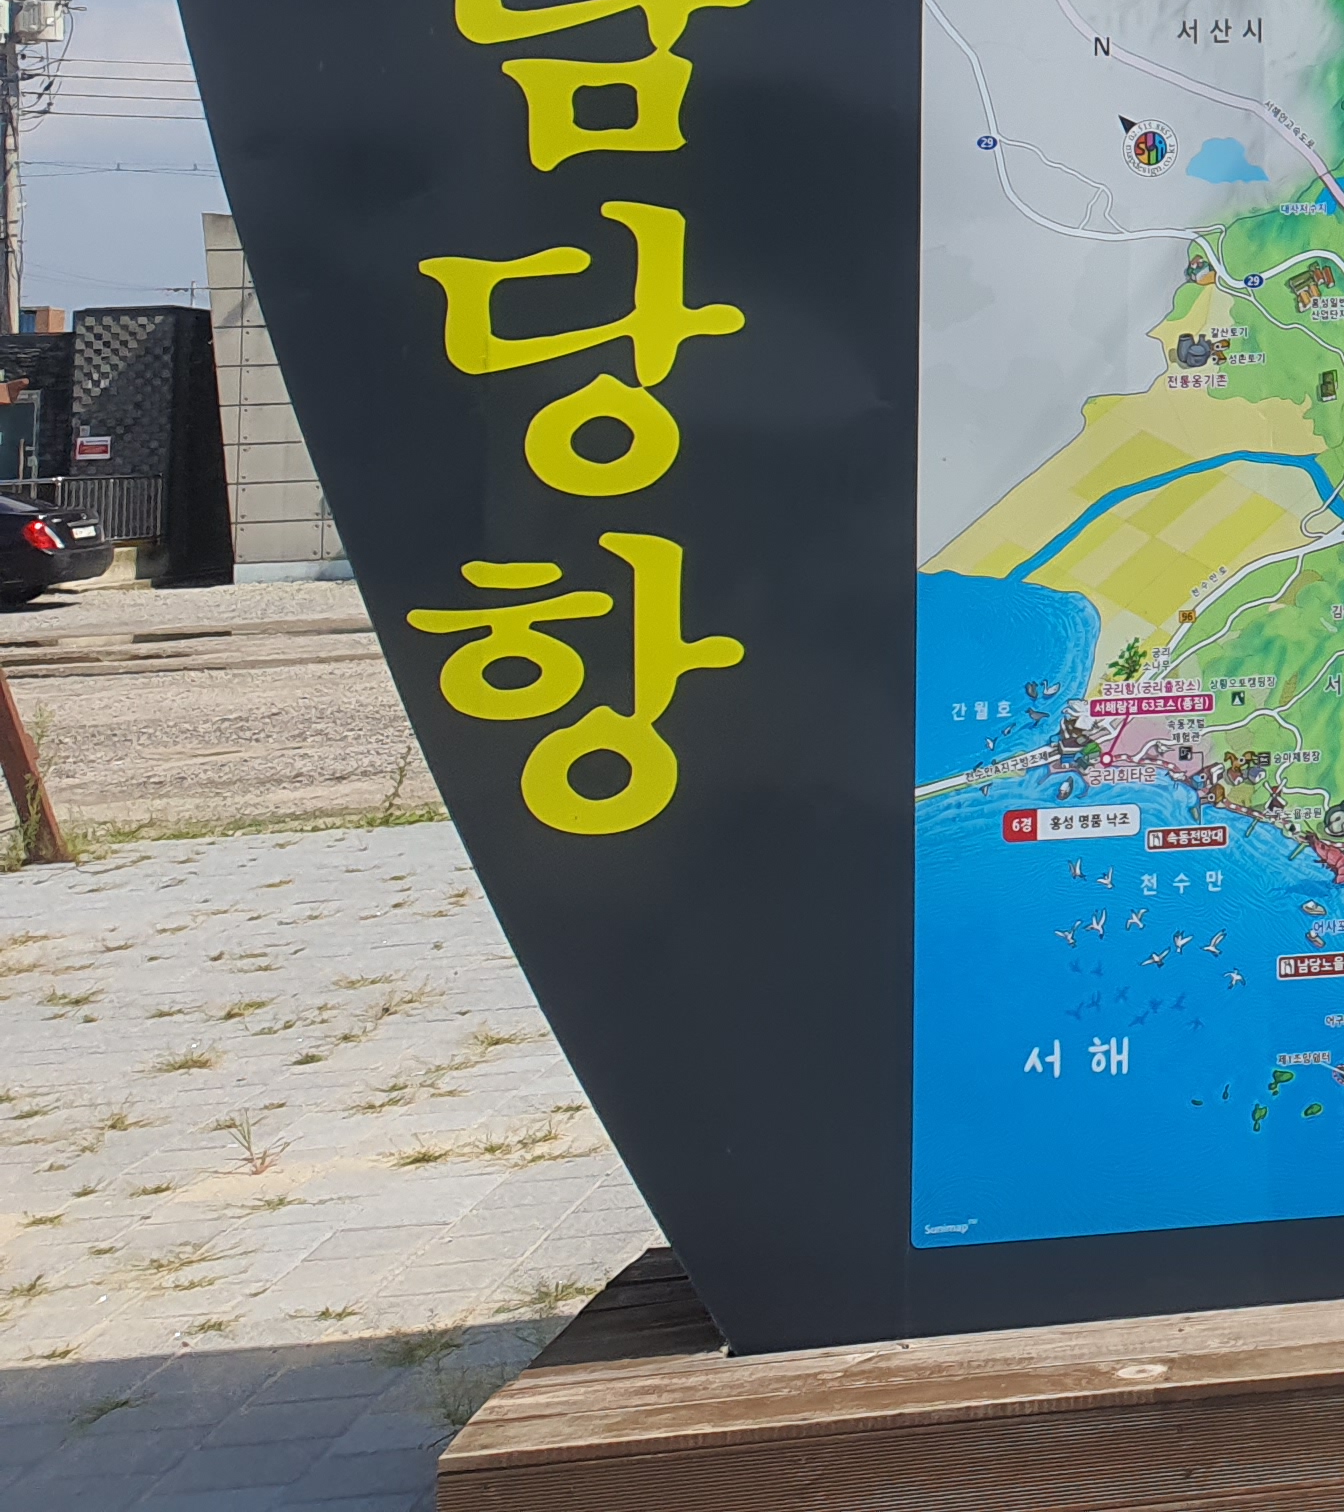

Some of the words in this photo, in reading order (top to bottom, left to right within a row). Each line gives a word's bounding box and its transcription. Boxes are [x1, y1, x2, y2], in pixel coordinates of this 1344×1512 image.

[1094, 37, 1110, 56] N
[980, 137, 995, 149] 29
[1210, 327, 1248, 339] 갈산토기
[1180, 611, 1194, 622] 96
[1090, 767, 1156, 784] 궁리회타운
[1012, 816, 1033, 834] 6경
[1050, 813, 1076, 832] 홍성
[1079, 812, 1104, 830] 명품
[1107, 812, 1130, 828] 낙조
[1167, 829, 1224, 846] 속동전망대
